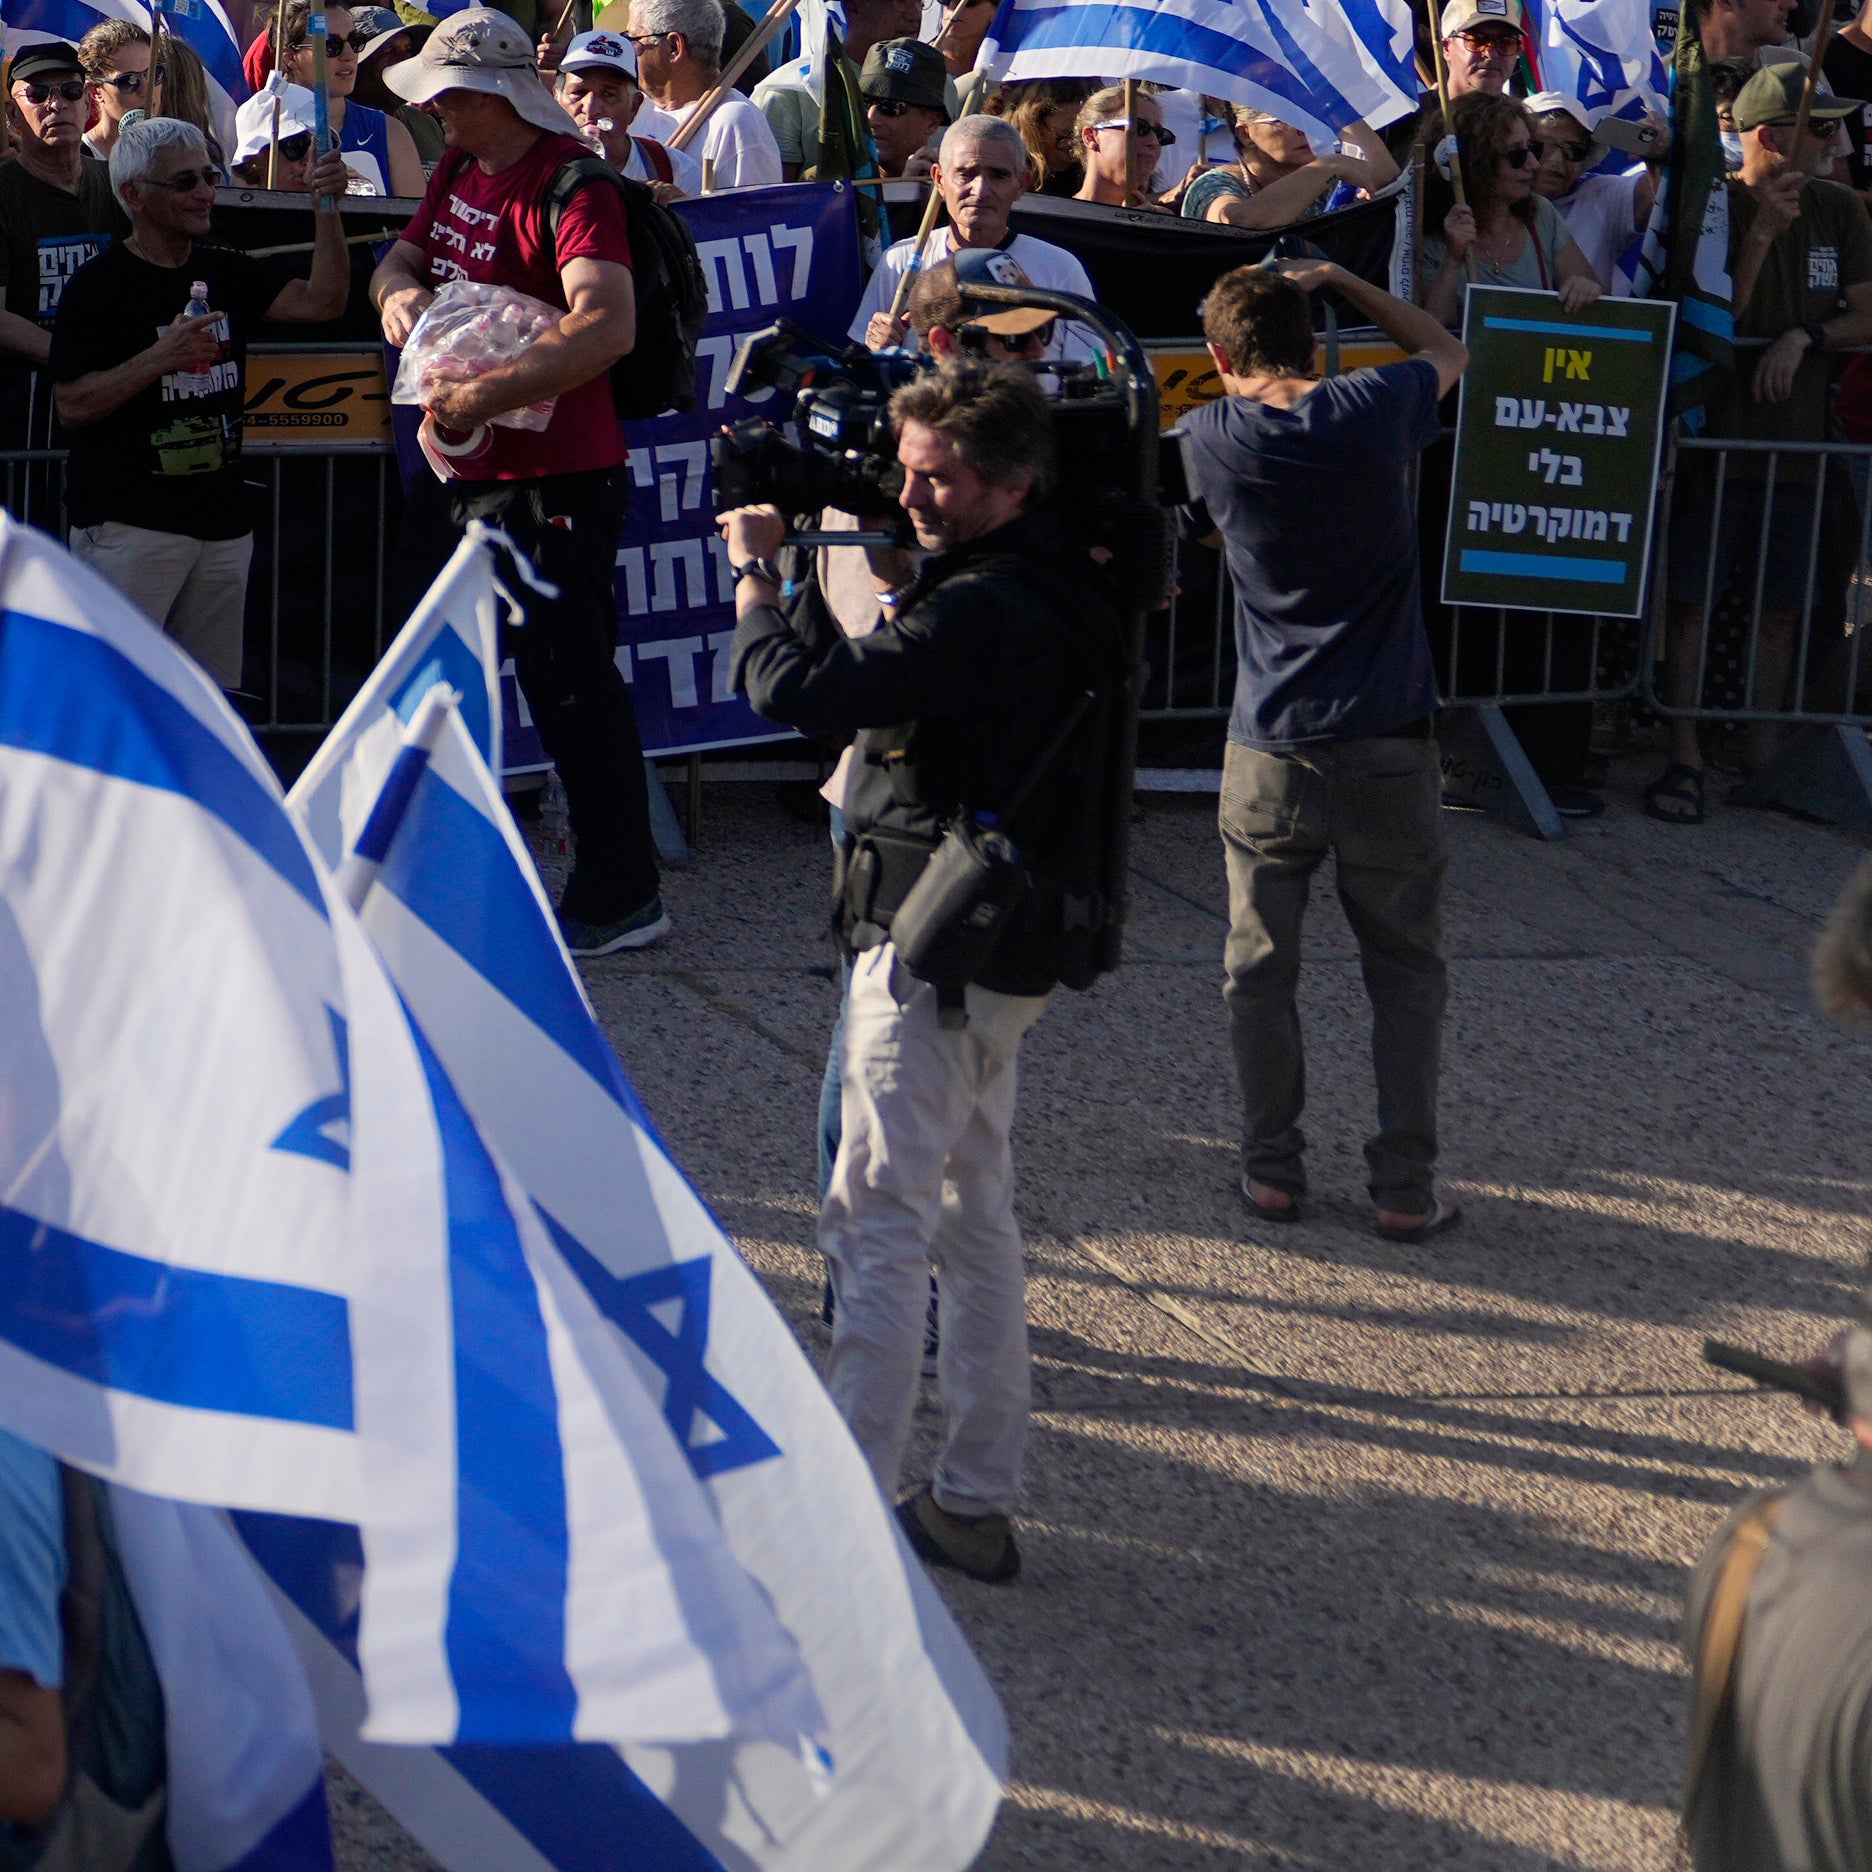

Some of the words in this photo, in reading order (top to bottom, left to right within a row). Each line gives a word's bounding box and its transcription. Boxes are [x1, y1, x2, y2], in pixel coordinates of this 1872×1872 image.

[1542, 348, 1592, 384] אין
[242, 414, 345, 426] 4-5559900
[1494, 396, 1630, 438] צבא-עם
[1528, 448, 1584, 488] בלי
[1467, 500, 1633, 545] דמוקרטיה
